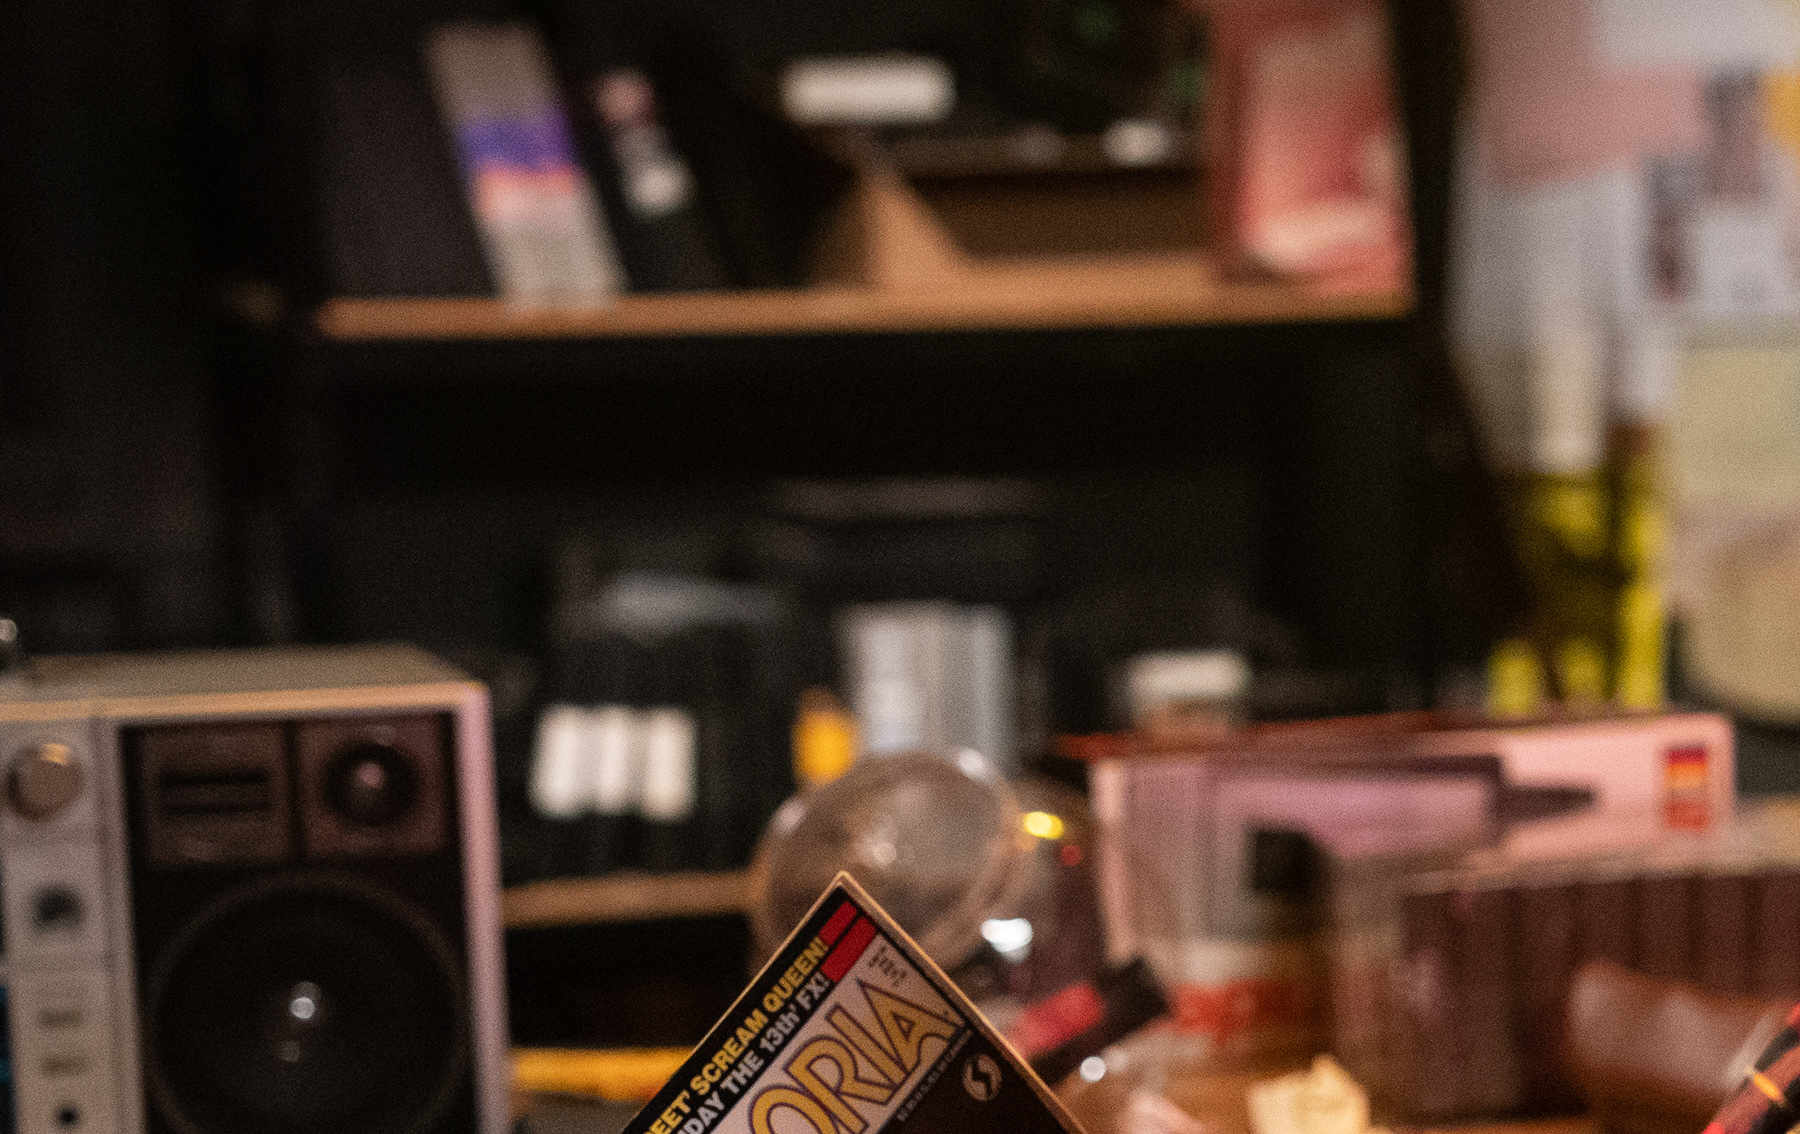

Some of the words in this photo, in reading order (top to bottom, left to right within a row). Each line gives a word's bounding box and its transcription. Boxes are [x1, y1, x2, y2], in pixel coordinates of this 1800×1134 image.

[691, 1010, 767, 1095] SCREAM
[764, 938, 827, 1012] QUEEN!
[721, 1051, 763, 1093] THE
[796, 973, 828, 1009] FX!
